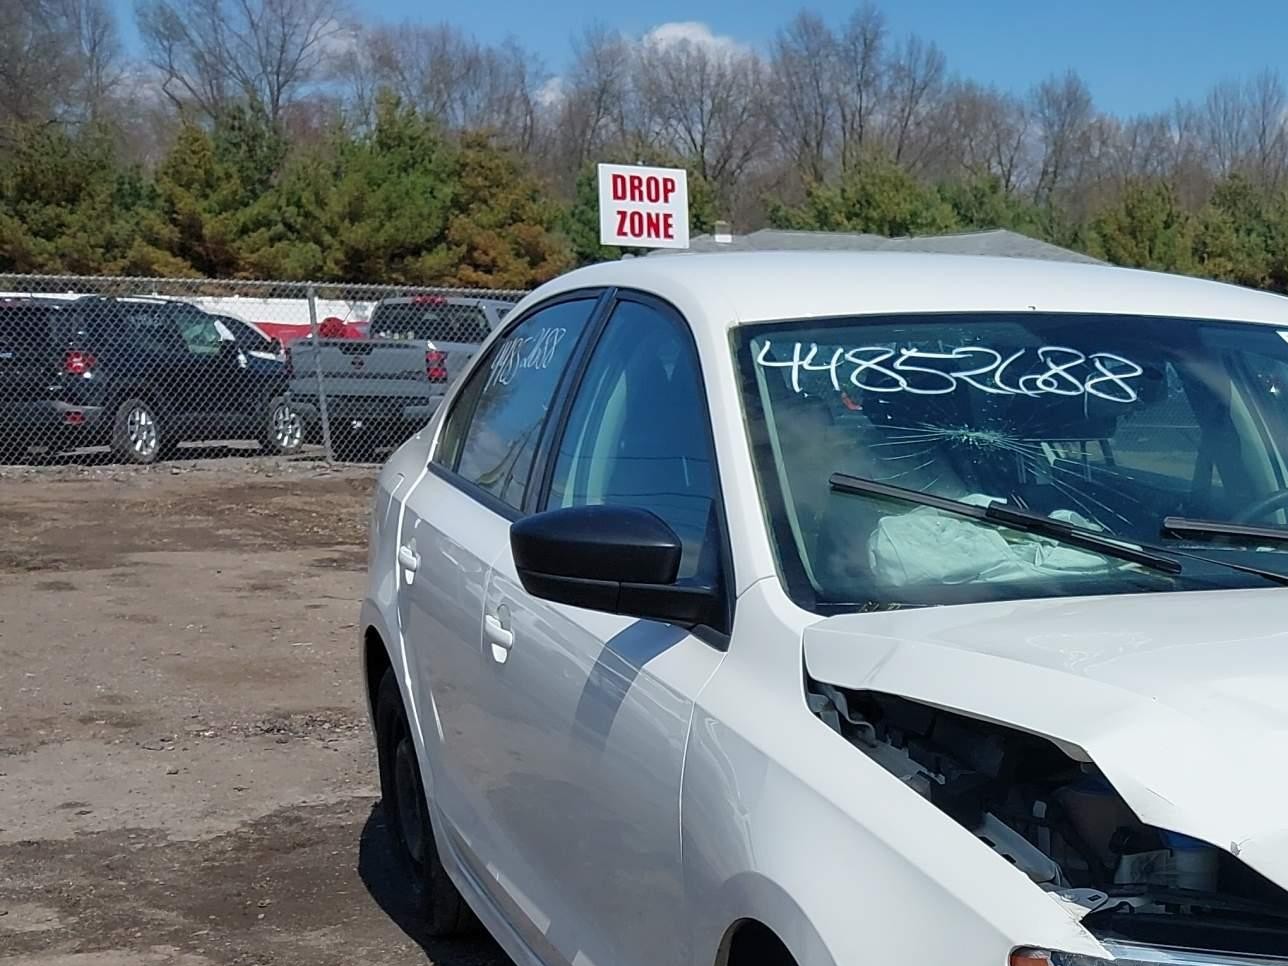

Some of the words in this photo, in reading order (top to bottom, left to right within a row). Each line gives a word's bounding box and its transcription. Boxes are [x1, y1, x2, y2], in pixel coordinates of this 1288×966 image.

[611, 173, 676, 204] DROP
[616, 210, 674, 240] ZONE
[757, 340, 1143, 403] 44852688
